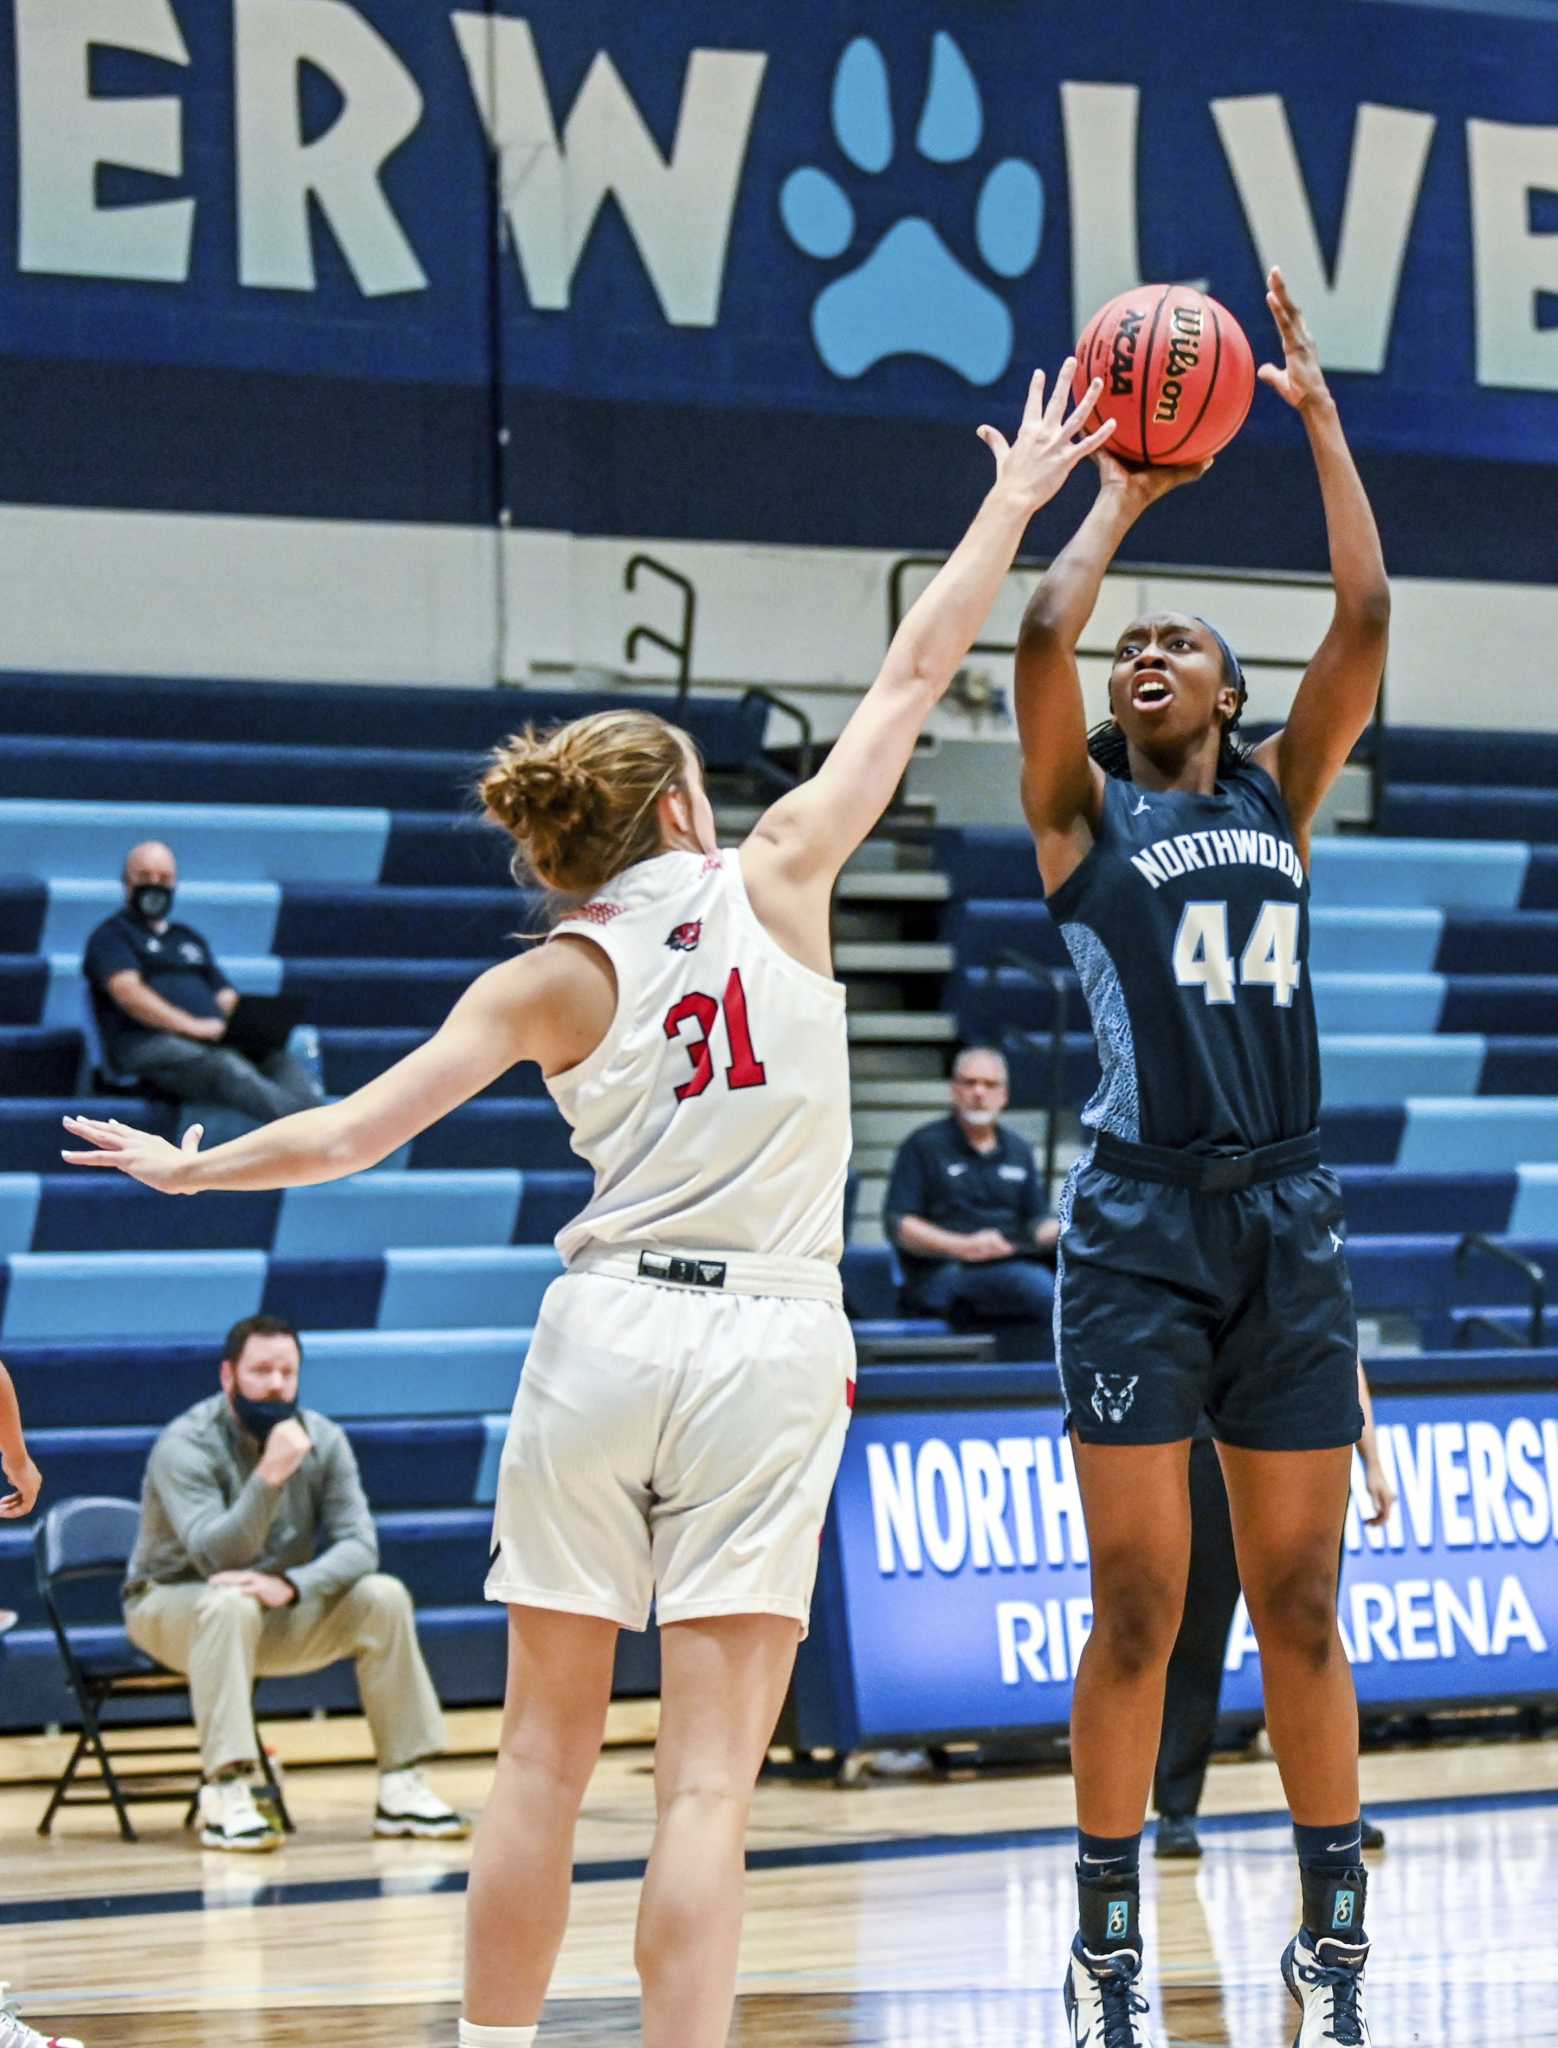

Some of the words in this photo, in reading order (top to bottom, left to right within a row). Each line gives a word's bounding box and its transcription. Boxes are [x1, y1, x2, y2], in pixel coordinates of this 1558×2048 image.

[1110, 309, 1146, 396] NCAA
[1152, 306, 1205, 424] Wilson
[1172, 900, 1301, 1008] 44
[663, 967, 767, 1104] 31
